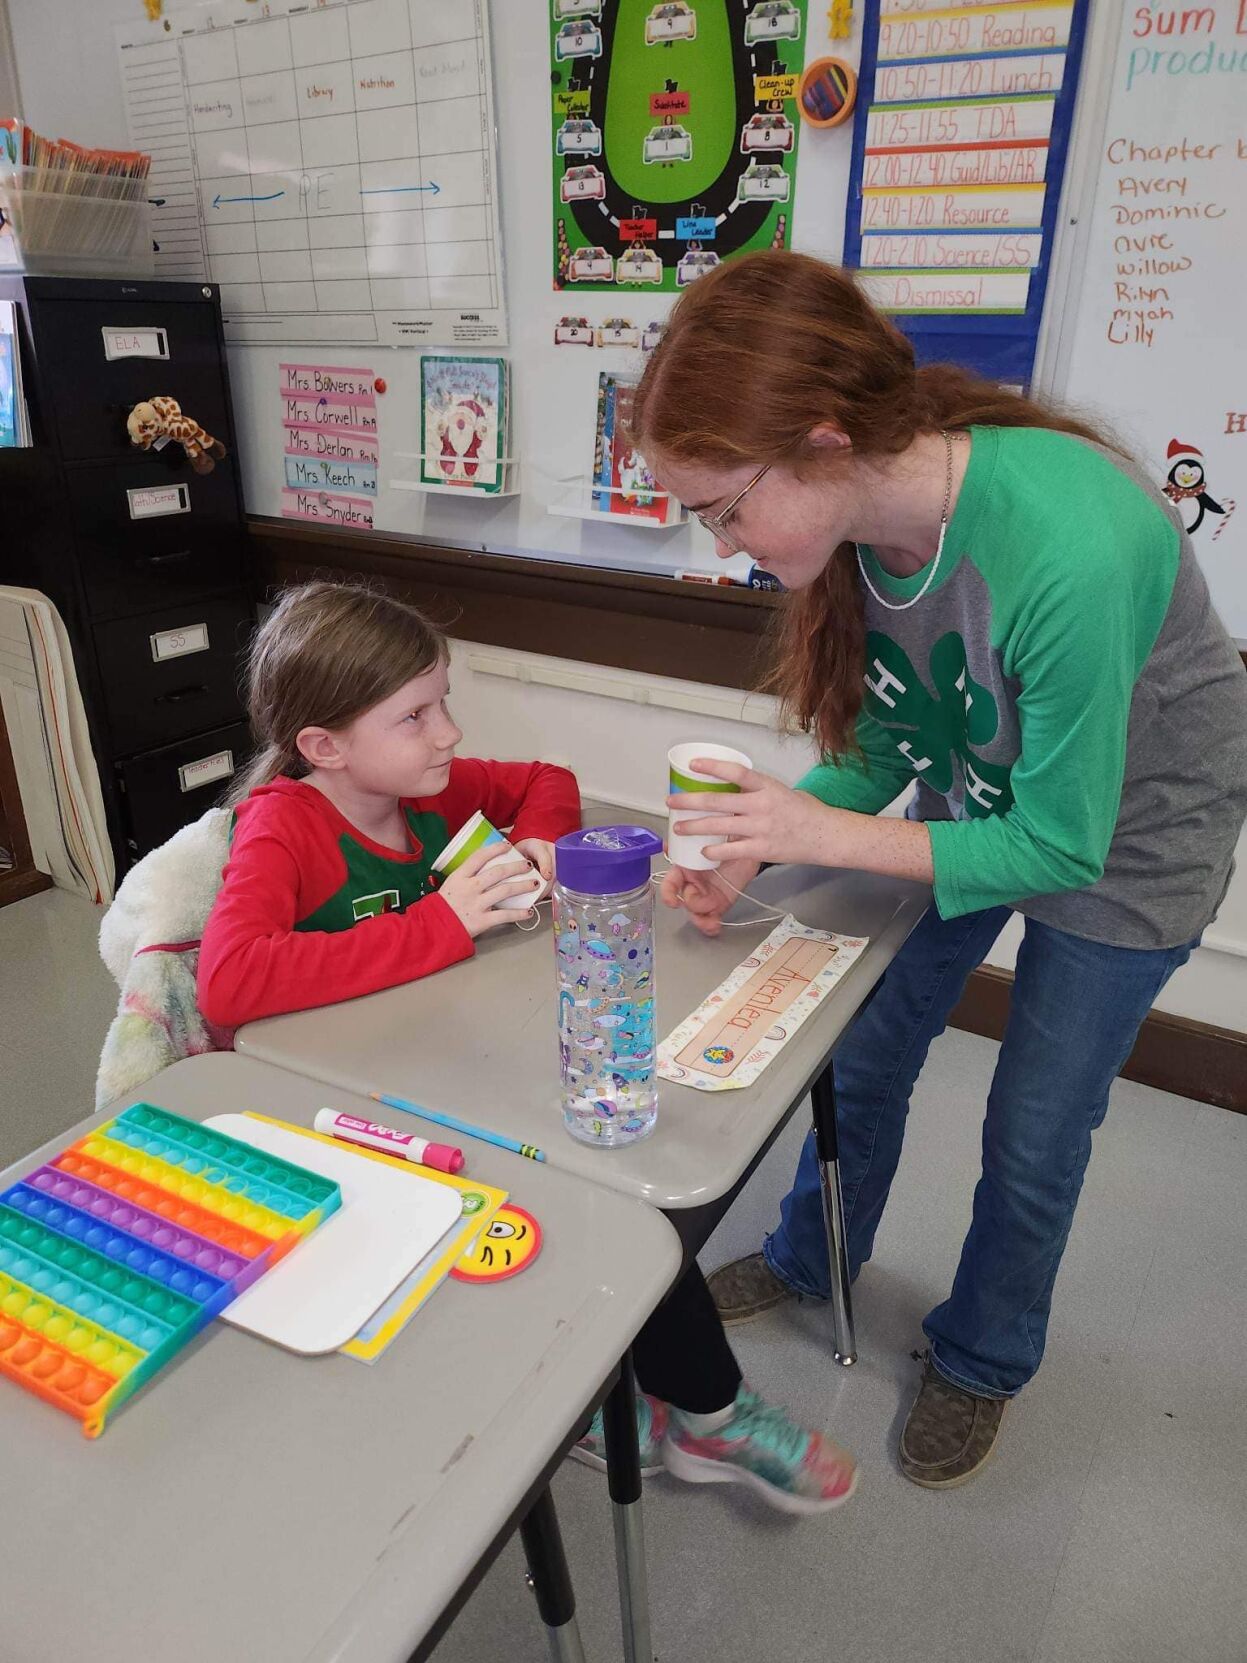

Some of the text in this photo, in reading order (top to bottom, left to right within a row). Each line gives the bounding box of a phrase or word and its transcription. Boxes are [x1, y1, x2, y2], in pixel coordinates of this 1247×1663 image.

[982, 14, 1056, 48] Reading
[990, 57, 1052, 93] Lunch
[1107, 137, 1222, 164] Chapter
[1118, 176, 1187, 197] Avery
[943, 194, 1010, 225] Resource
[1110, 202, 1226, 225] Dominic
[894, 277, 983, 306] Dismissal
[115, 336, 141, 350] ELA
[324, 464, 355, 486] Keech
